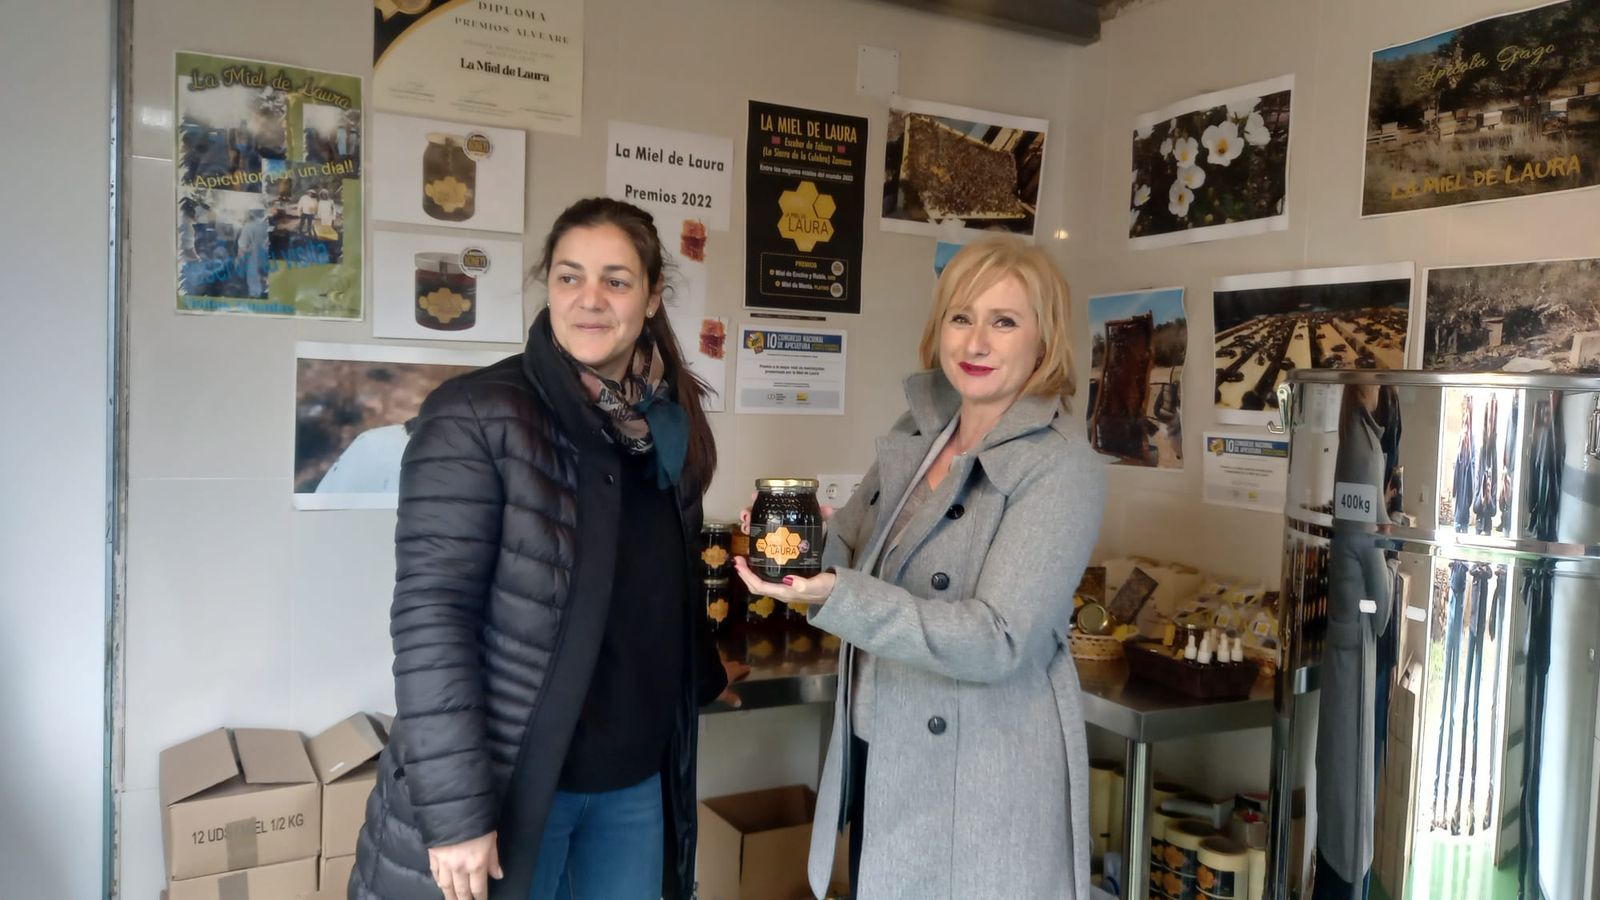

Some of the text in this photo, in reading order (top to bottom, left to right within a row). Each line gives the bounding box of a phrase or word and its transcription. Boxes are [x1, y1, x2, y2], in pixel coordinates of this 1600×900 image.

[478, 0, 547, 22] DIPLOMA
[455, 17, 569, 44] PREMIOS ALVEARE
[460, 58, 550, 82] La Miel de Laura
[1496, 44, 1556, 71] Gago
[189, 67, 351, 109] La Miel de Laura
[761, 113, 857, 143] LA MIEL DE LAURA
[615, 143, 725, 172] La Miel de Laura
[269, 167, 294, 184] por
[299, 164, 318, 177] un
[321, 160, 353, 177] día!!
[1390, 154, 1581, 200] LA MIEL DE LAURA
[625, 184, 712, 209] Premios 2022
[788, 216, 829, 235] LAURA
[766, 332, 777, 349] 10
[1341, 494, 1370, 513] 400kg
[770, 546, 797, 556] LAURA
[192, 830, 205, 844] 12
[271, 816, 286, 831] 1/2
[288, 813, 304, 828] KG
